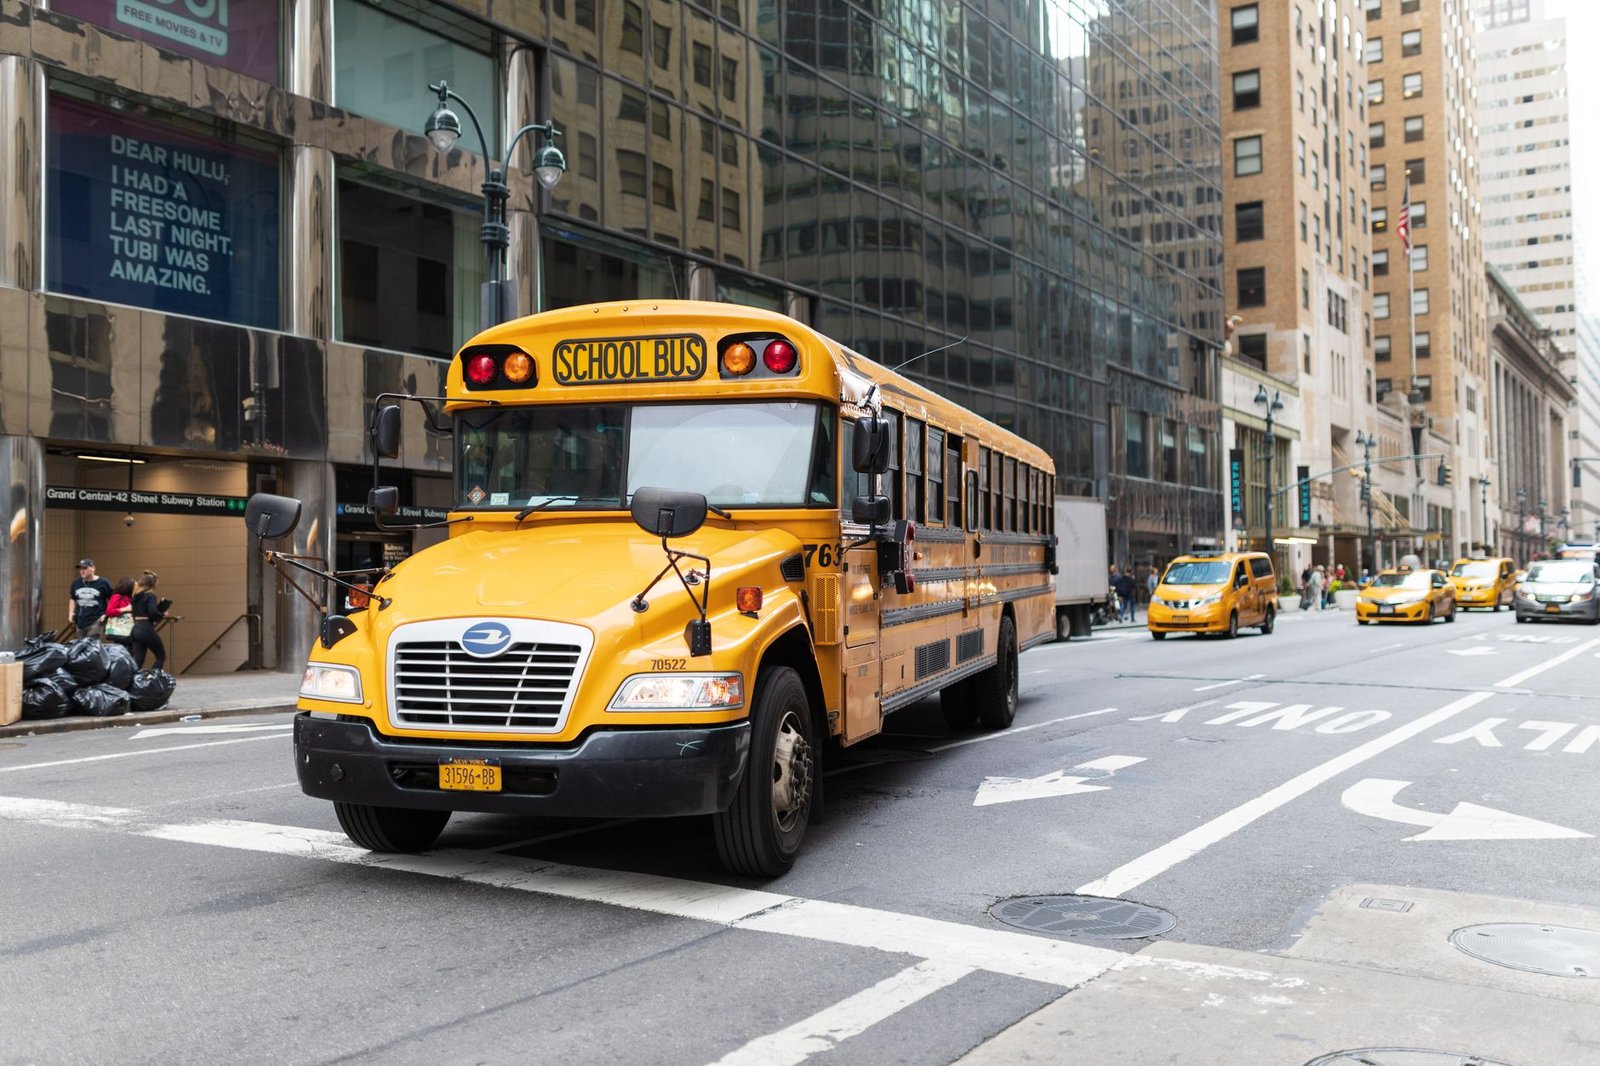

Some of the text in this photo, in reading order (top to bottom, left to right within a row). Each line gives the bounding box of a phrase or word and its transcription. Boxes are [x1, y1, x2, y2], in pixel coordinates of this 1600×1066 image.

[123, 5, 153, 23] FREE
[155, 17, 197, 39] MOVIES
[199, 32, 207, 43] &
[208, 35, 223, 48] TV
[111, 133, 231, 186] DEAR HULU,
[111, 164, 188, 201] I HAD A
[110, 187, 221, 231] FREESOME
[110, 211, 234, 256] LAST NIGHT.
[109, 234, 210, 272] TUBI WAS
[109, 259, 211, 295] AMAZING.
[557, 338, 701, 381] SCHOOL BUS
[46, 488, 76, 500] Grand
[78, 489, 128, 503] Central-42
[130, 493, 158, 504] Street
[161, 494, 194, 507] Subway
[196, 497, 226, 508] Station
[1231, 461, 1240, 513] MARKET
[344, 504, 365, 514] Grand
[402, 507, 422, 517] Street
[423, 508, 447, 519] Subway
[650, 659, 687, 671] 70522
[1128, 700, 1393, 734] ONLY
